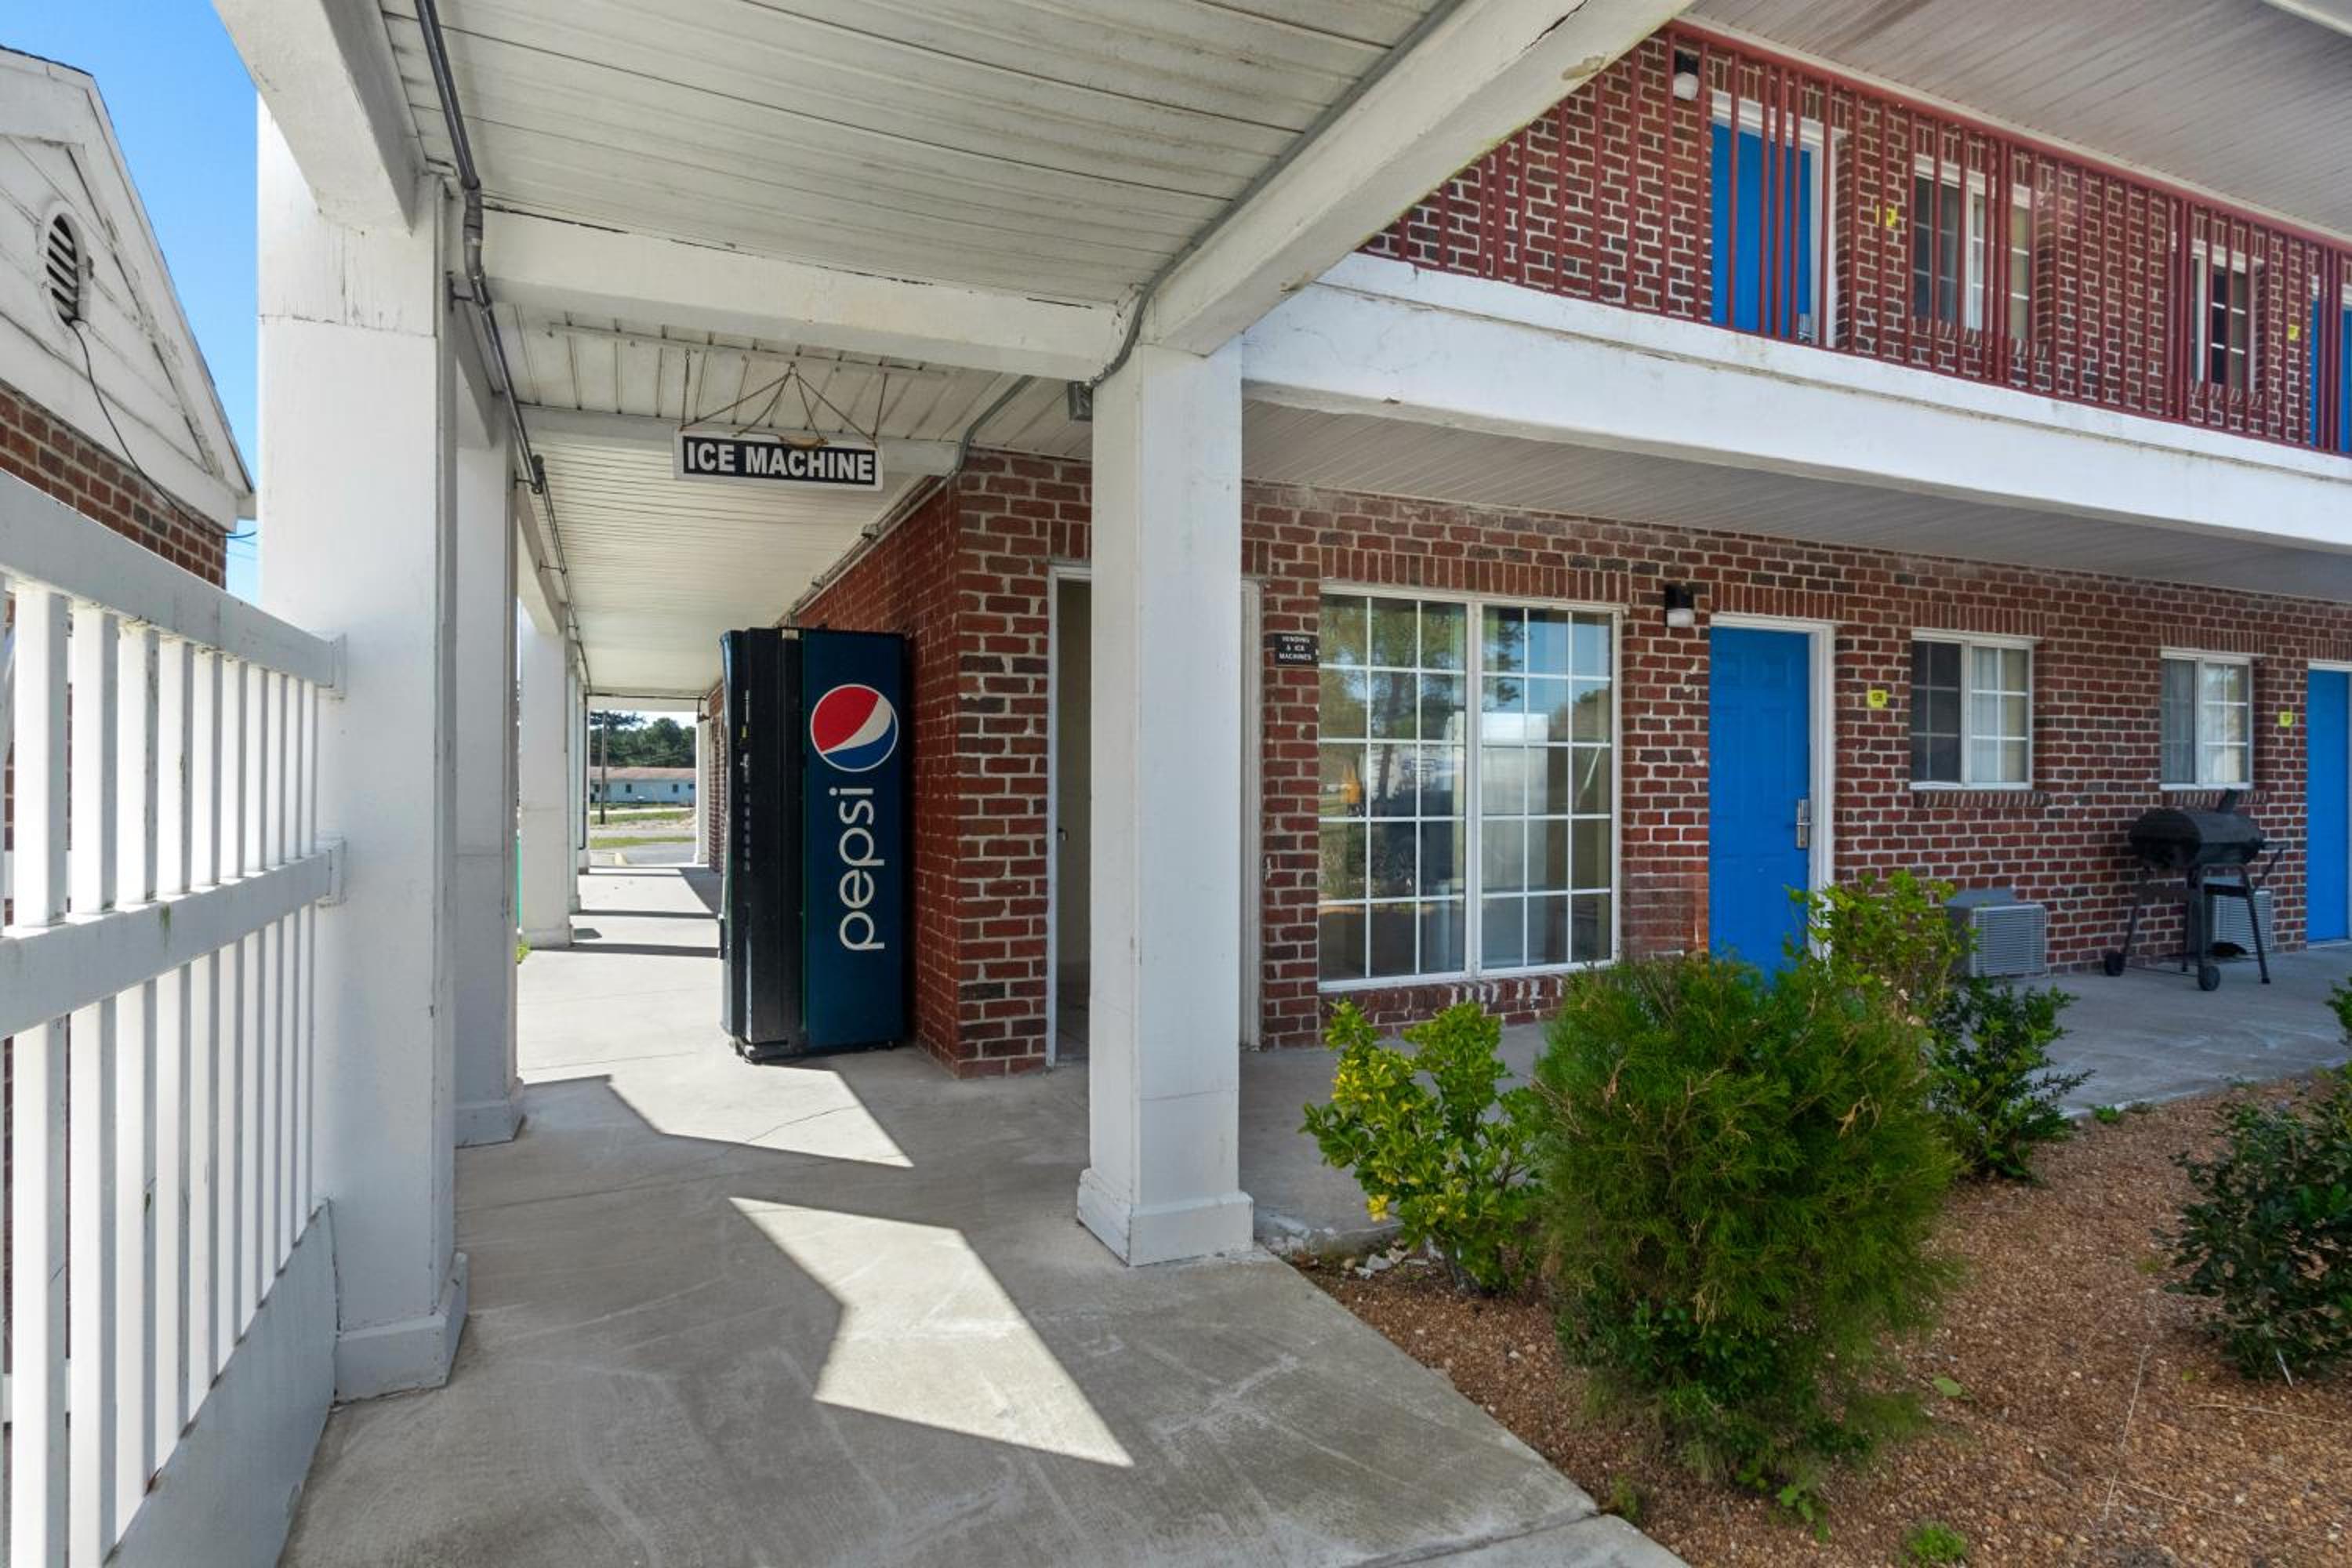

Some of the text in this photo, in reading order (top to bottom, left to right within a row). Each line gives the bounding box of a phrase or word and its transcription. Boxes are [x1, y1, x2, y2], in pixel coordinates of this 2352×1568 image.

[687, 441, 873, 481] ICE MACHINE
[1279, 652, 1312, 661] MACHINES
[829, 787, 885, 949] pepsi
